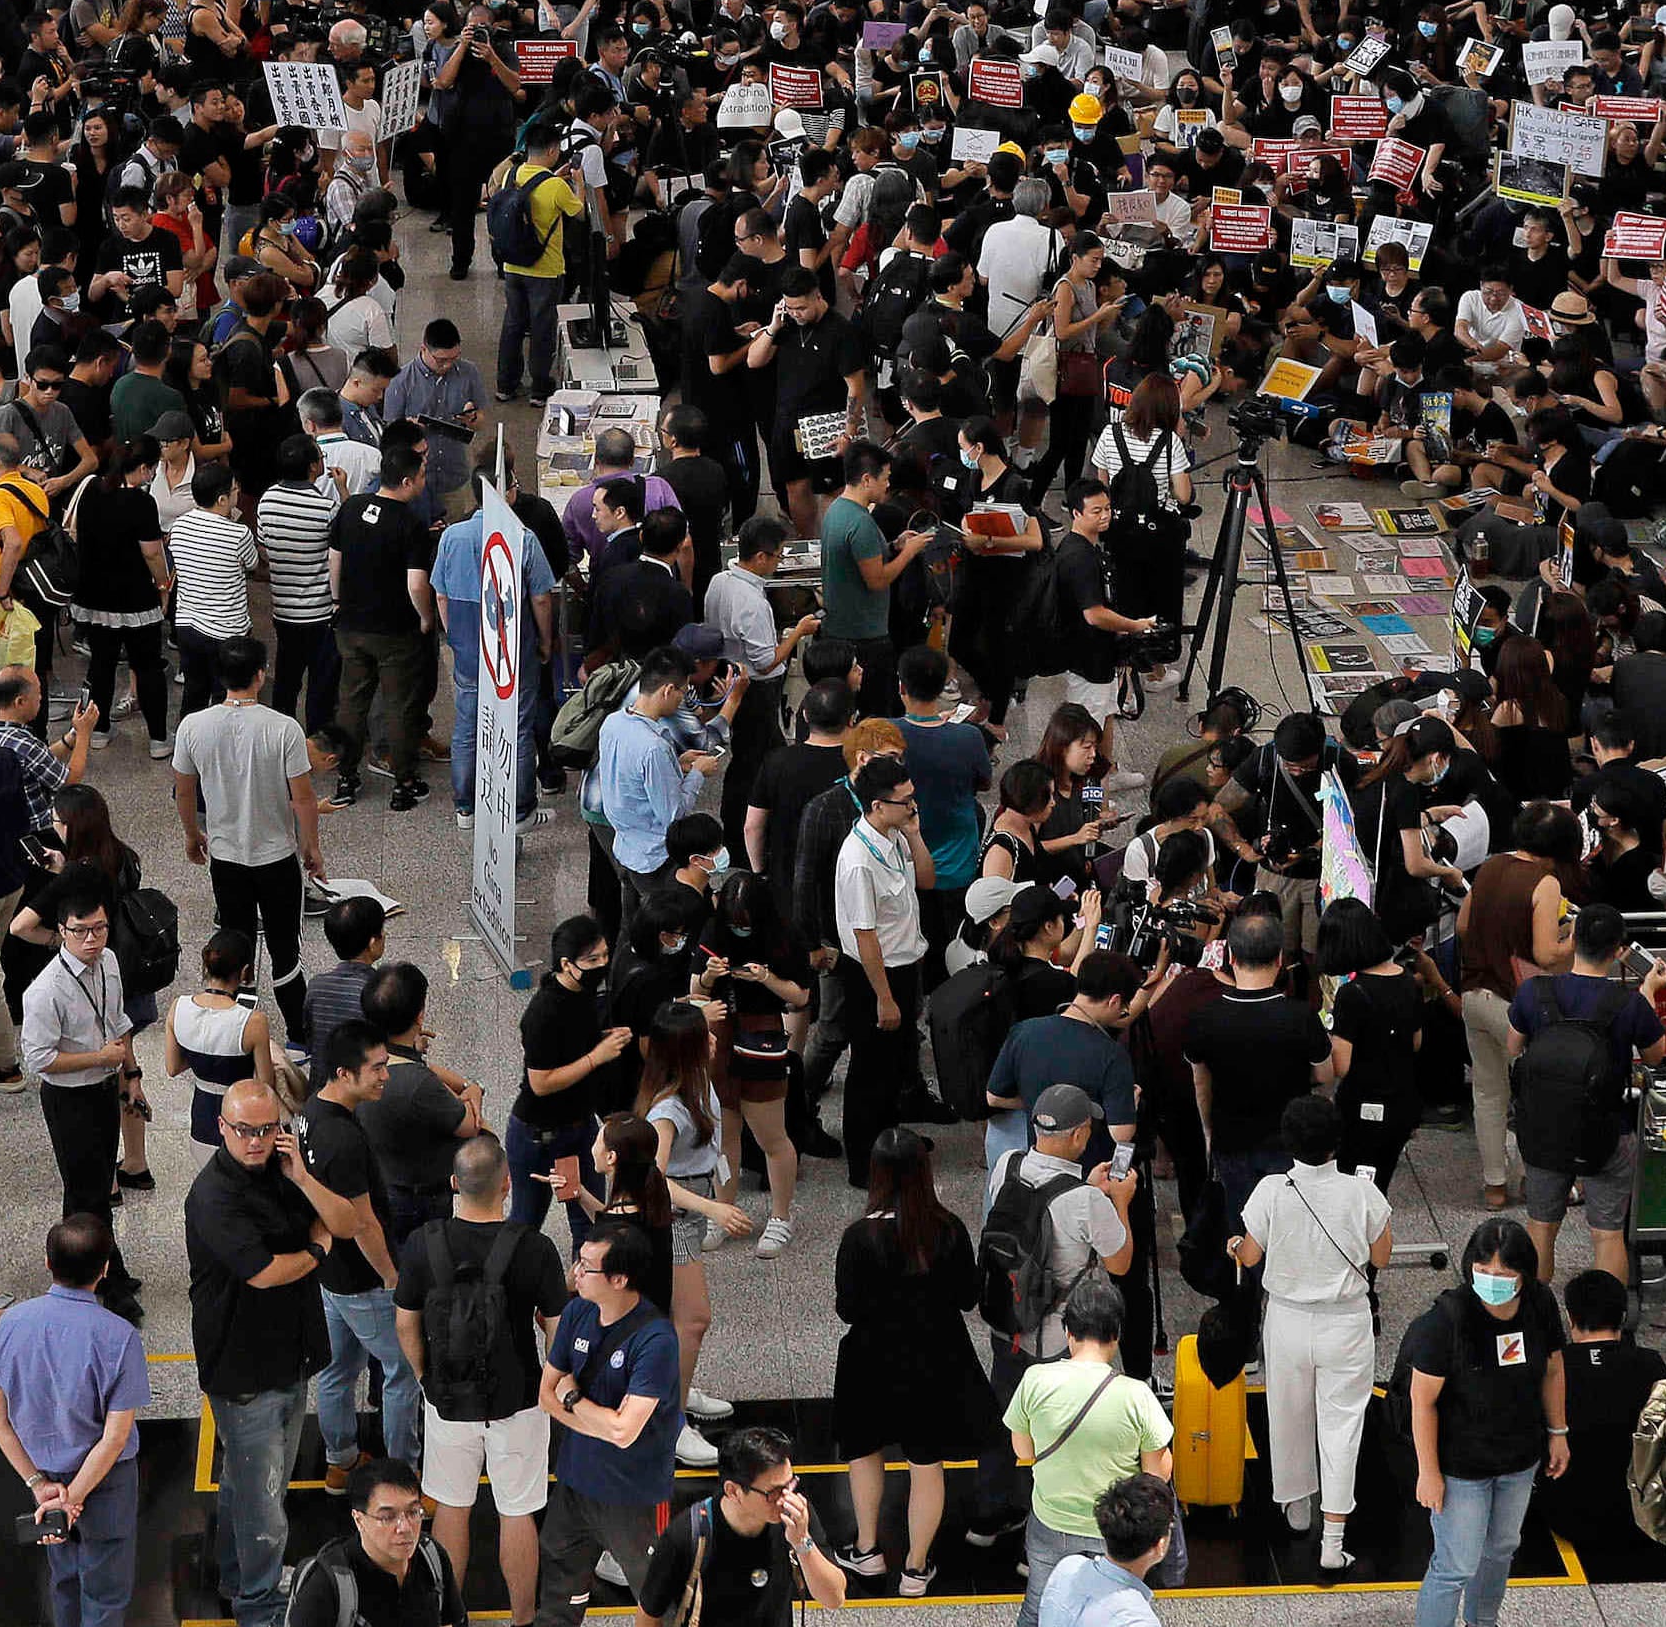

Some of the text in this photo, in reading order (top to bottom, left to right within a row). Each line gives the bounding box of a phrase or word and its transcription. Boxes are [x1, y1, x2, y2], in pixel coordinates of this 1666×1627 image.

[271, 65, 294, 125] 出賣警察
[287, 65, 310, 125] 出賣祖國
[303, 65, 326, 127] 出賣香港
[720, 104, 770, 114] Extradition
[738, 88, 765, 98] China
[1517, 104, 1533, 119] HK
[1546, 112, 1569, 126] NOT
[1573, 116, 1601, 130] SAFE
